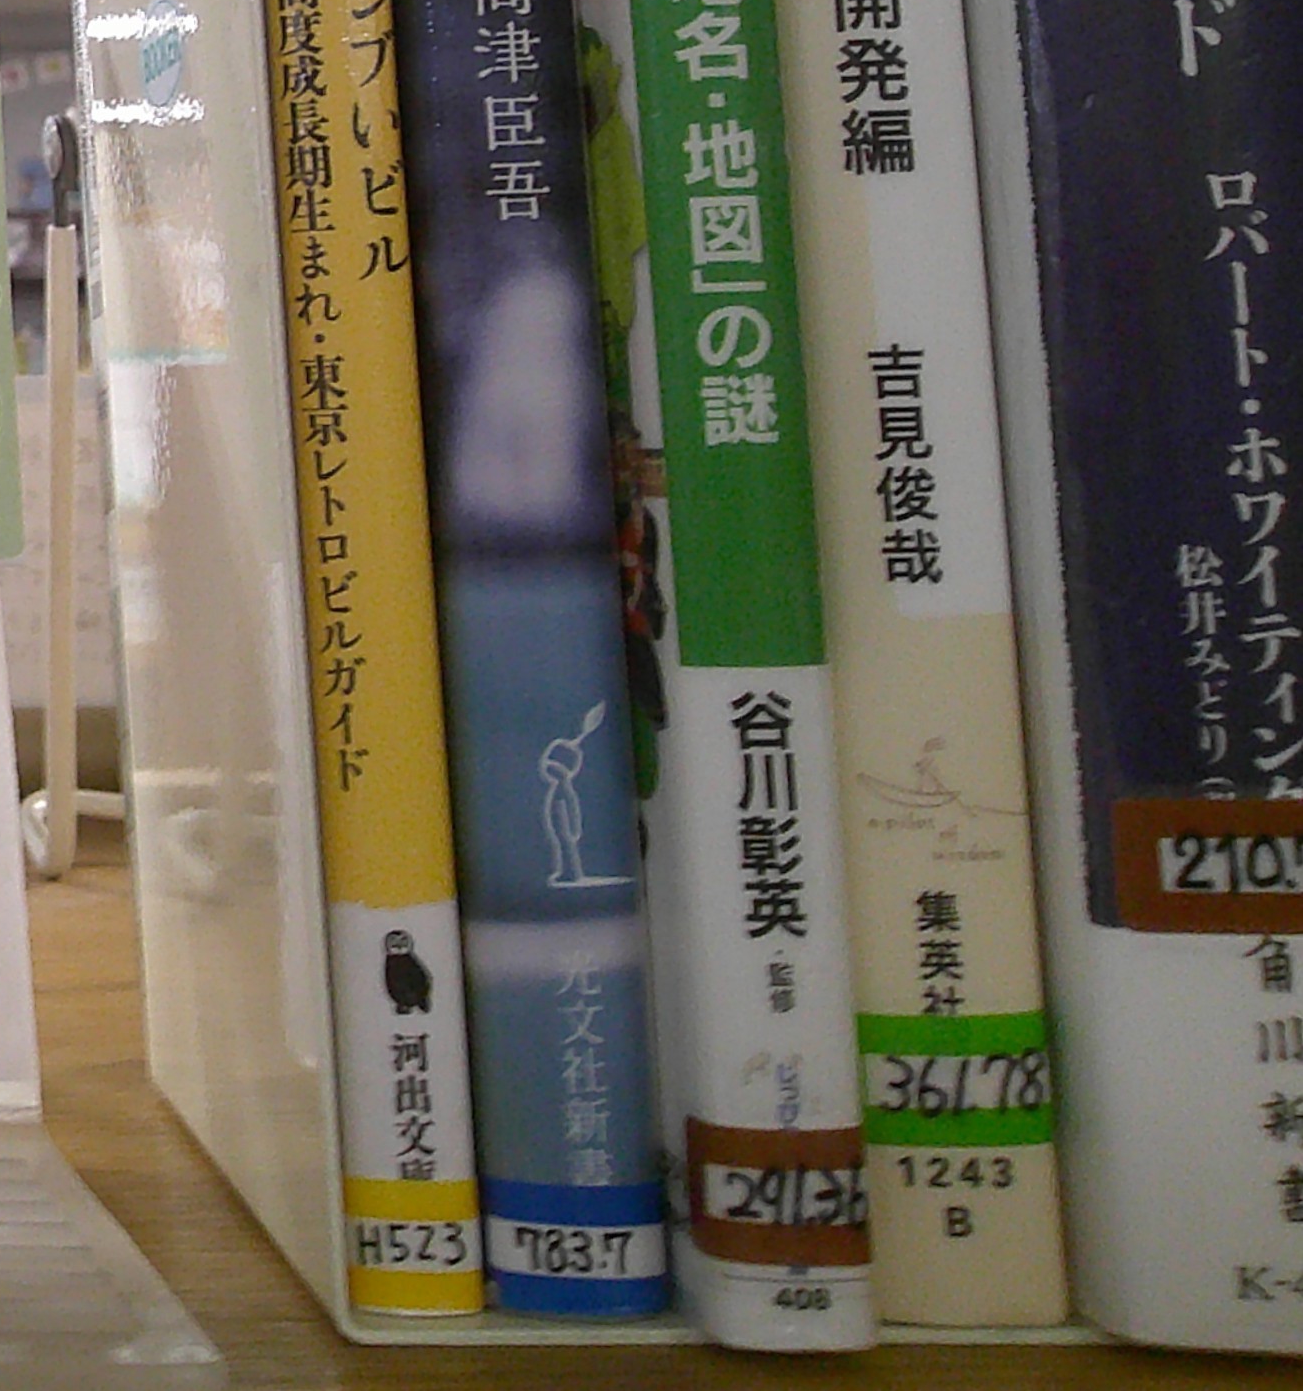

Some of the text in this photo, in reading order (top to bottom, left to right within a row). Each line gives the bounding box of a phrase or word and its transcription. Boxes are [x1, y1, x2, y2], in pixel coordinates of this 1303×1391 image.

[867, 343, 944, 585] 吉見俊哉
[729, 690, 807, 940] 谷川彰英
[1173, 831, 1303, 892] 210.
[897, 1154, 1015, 1190] 1243
[943, 1205, 972, 1239] B
